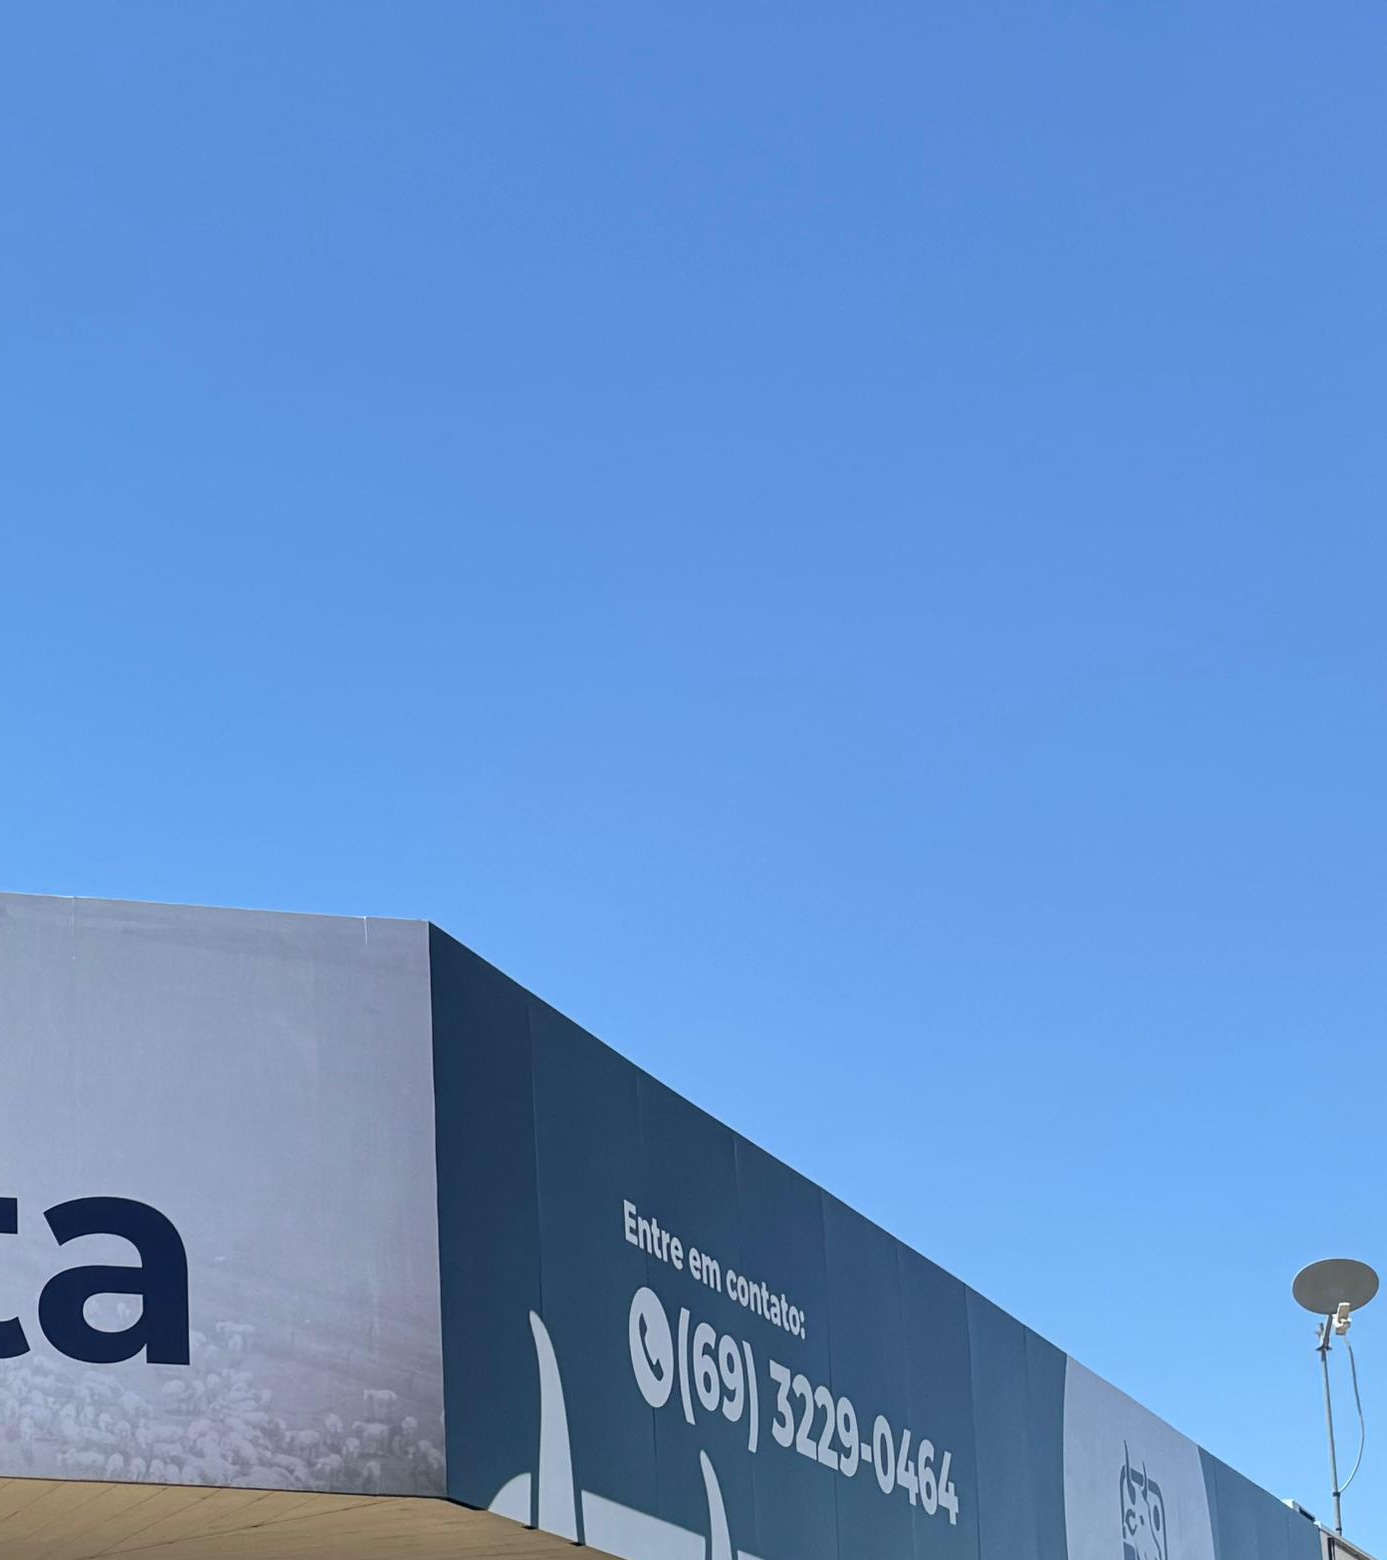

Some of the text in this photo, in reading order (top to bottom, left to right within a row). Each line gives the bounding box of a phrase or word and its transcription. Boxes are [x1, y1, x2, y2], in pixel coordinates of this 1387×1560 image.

[623, 1199, 806, 1341] Entre em contato:
[678, 1307, 960, 1526] (69) 3229-0464
